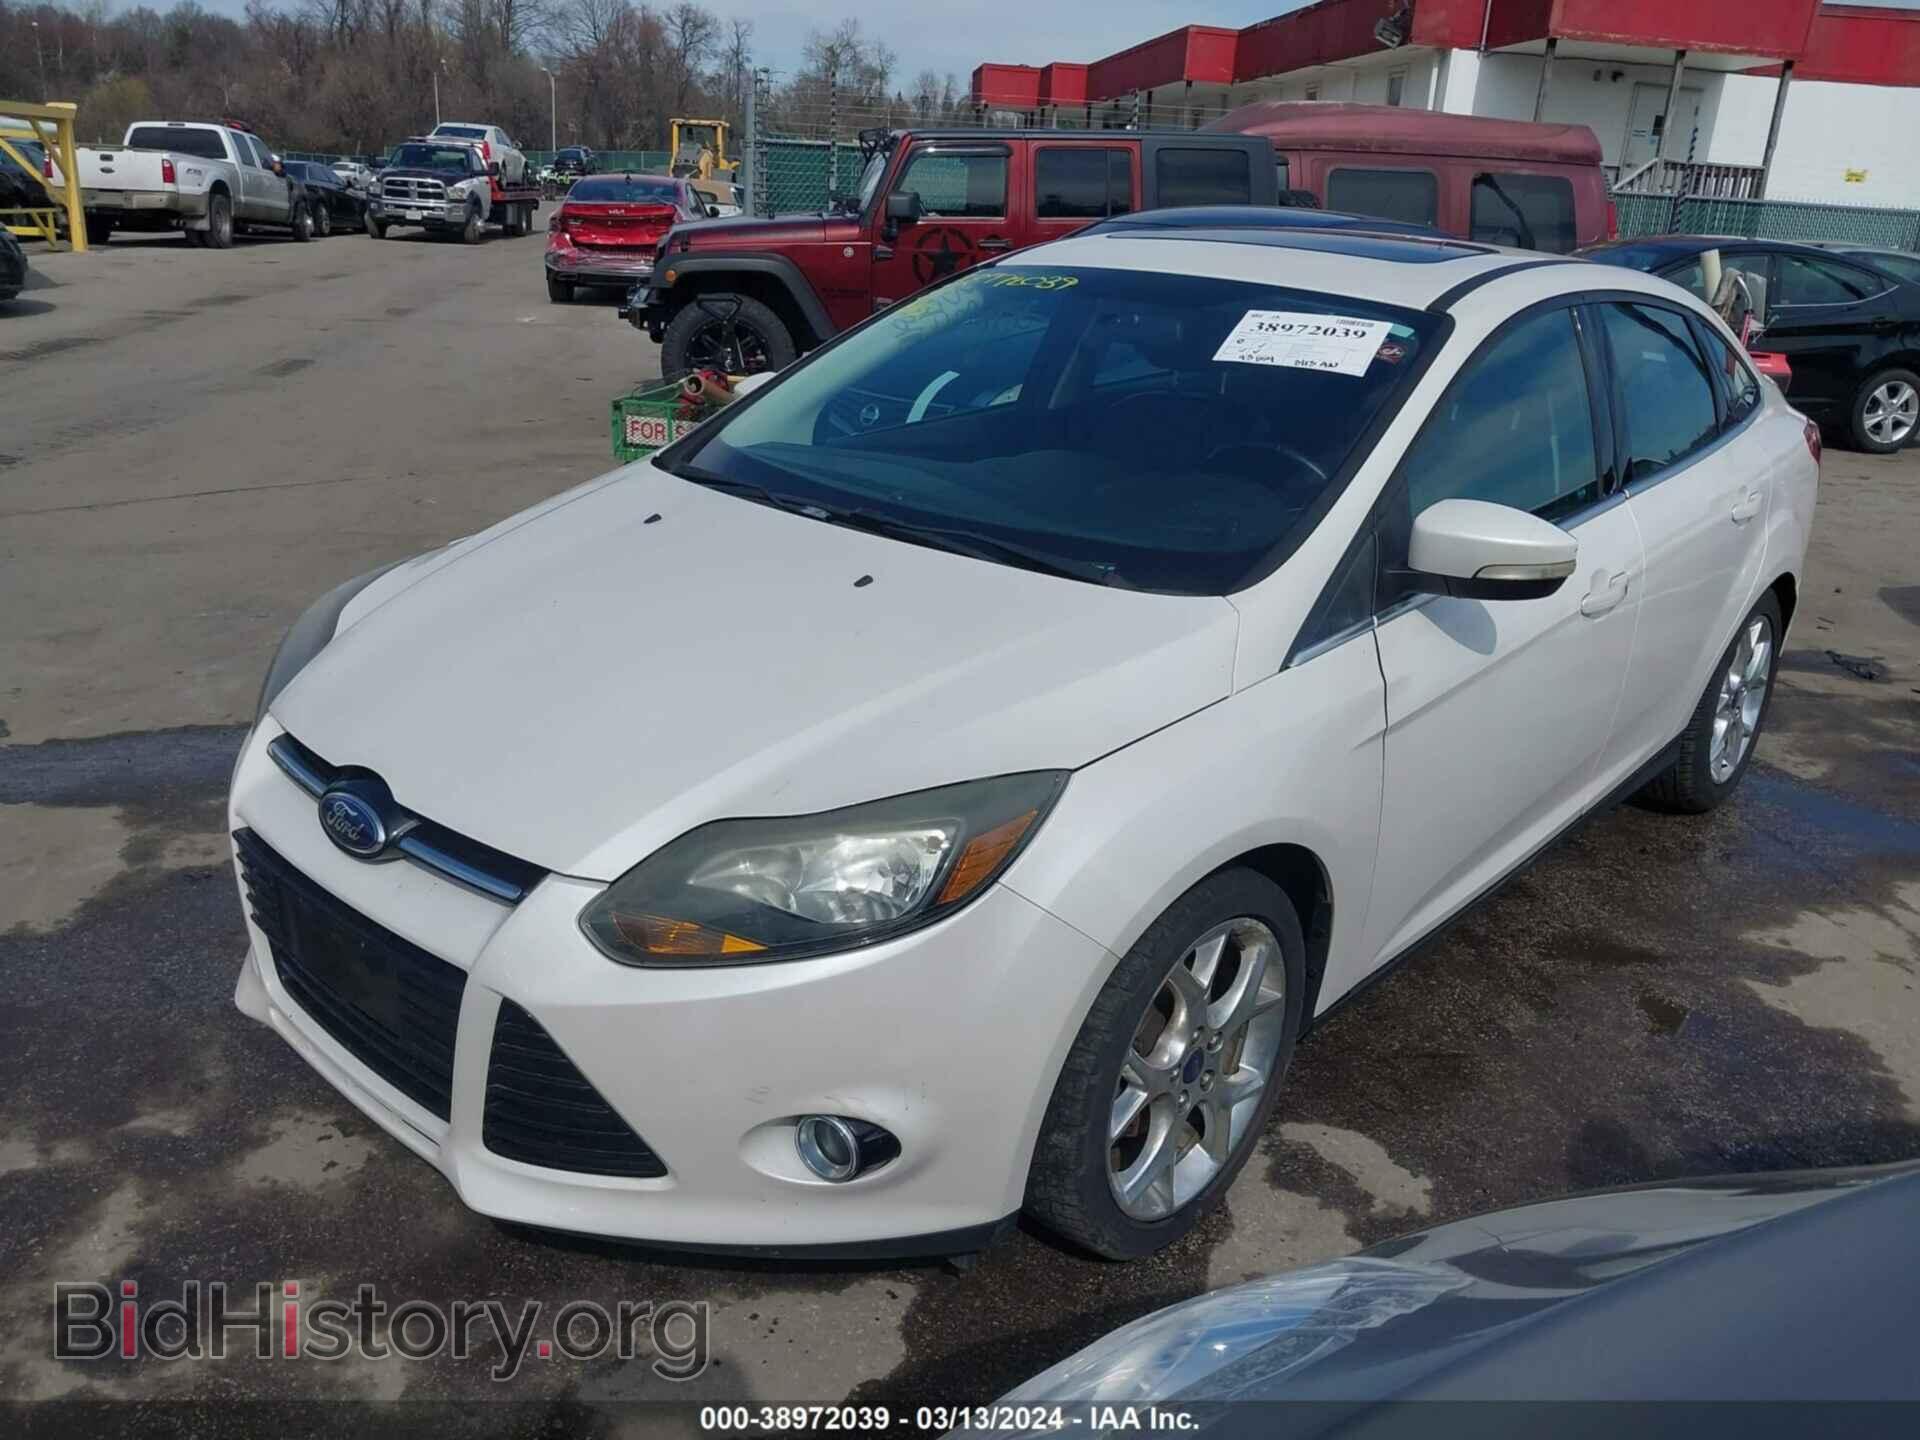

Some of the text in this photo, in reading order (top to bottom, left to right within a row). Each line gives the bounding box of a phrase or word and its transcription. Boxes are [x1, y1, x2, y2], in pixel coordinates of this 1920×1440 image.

[1250, 321, 1368, 340] 38972039
[630, 420, 666, 441] FOR
[327, 801, 365, 841] Ford
